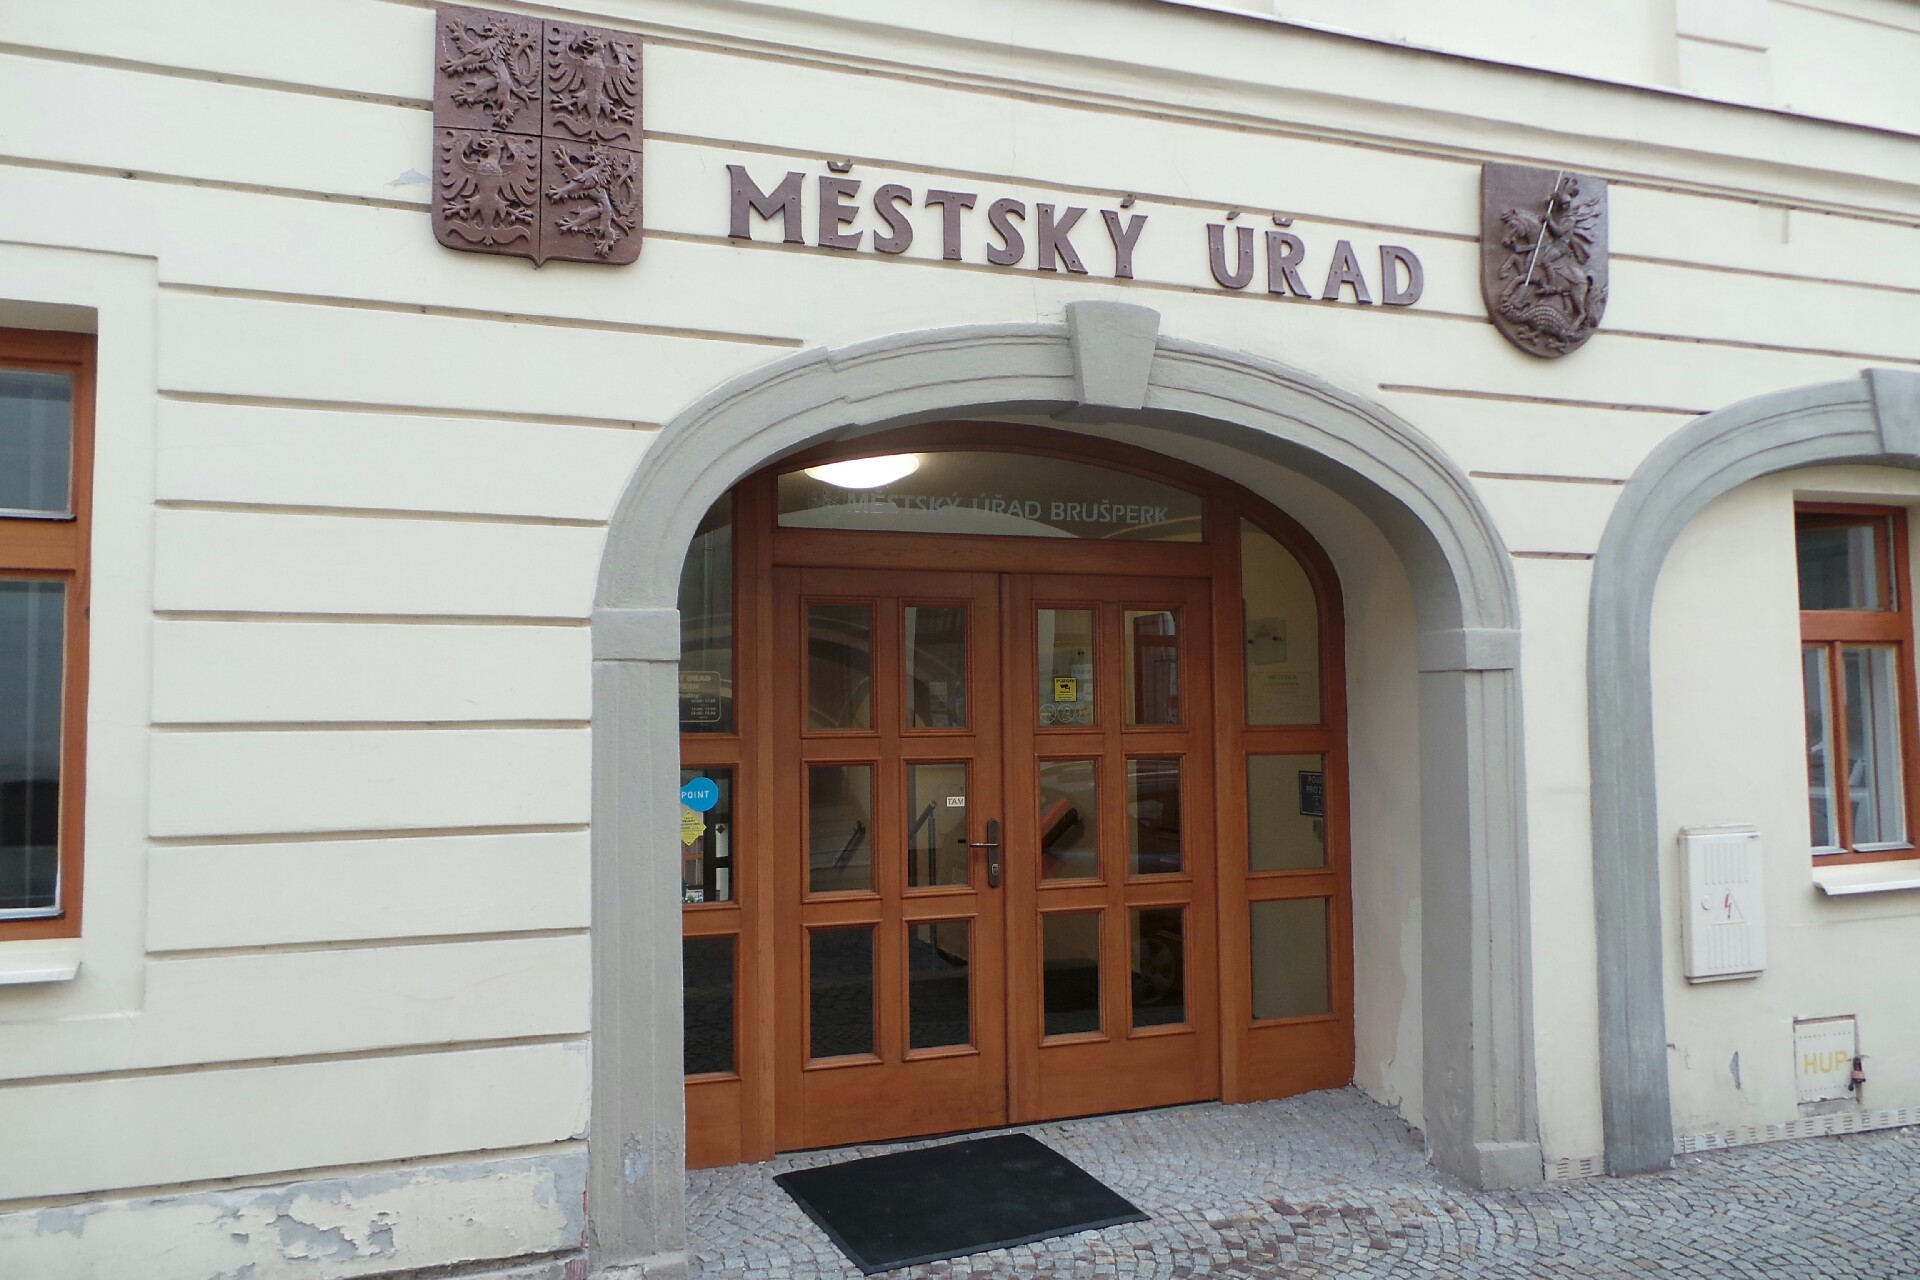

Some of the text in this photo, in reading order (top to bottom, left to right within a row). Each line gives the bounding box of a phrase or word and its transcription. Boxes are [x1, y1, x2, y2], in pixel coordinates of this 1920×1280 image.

[725, 160, 1425, 307] MĚSTSKÝ ÚŘAD
[972, 492, 1042, 520] ÚŘAD
[1050, 499, 1169, 525] BRUŠPERK
[681, 790, 710, 799] POINT
[1803, 1050, 1849, 1075] HUP
